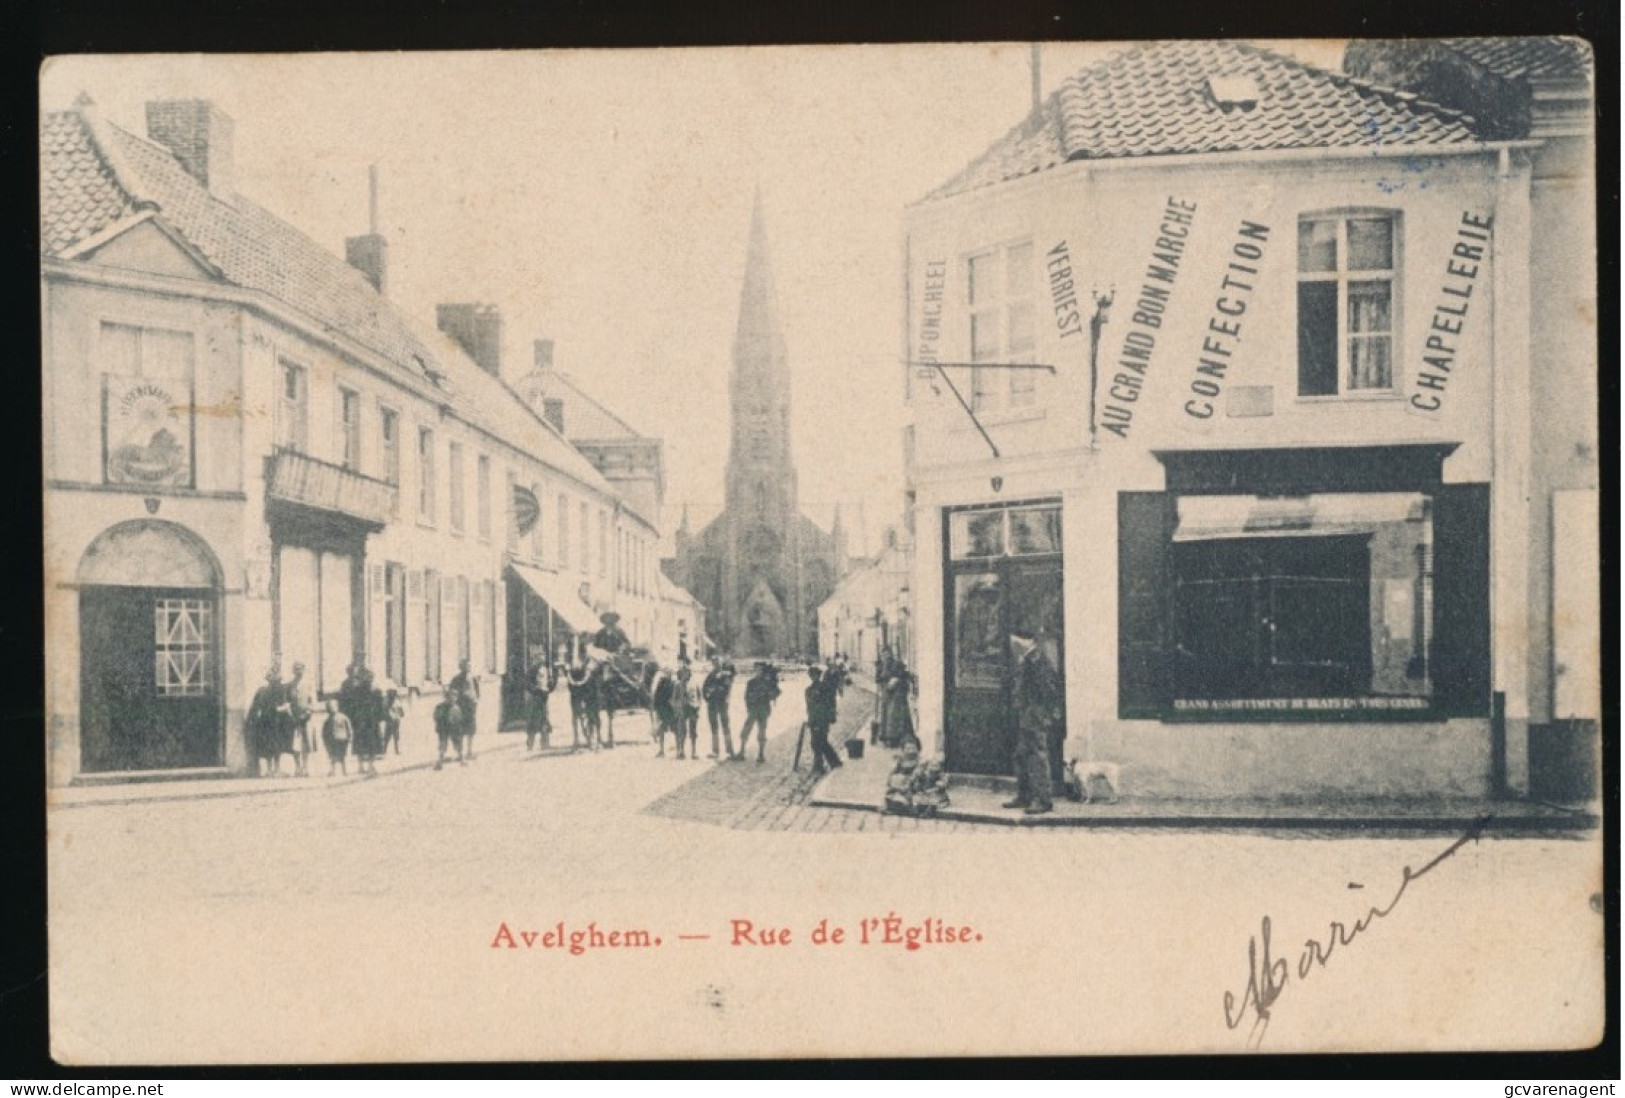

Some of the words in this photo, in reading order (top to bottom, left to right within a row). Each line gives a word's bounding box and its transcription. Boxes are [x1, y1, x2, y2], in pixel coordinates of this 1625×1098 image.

[1046, 239, 1083, 339] VERRIEST
[1132, 284, 1172, 329] BON
[1184, 219, 1271, 420] CONFECTION
[1410, 210, 1492, 412] CHAPELLERIE
[1110, 331, 1156, 410] GRAND
[1101, 402, 1135, 438] AU
